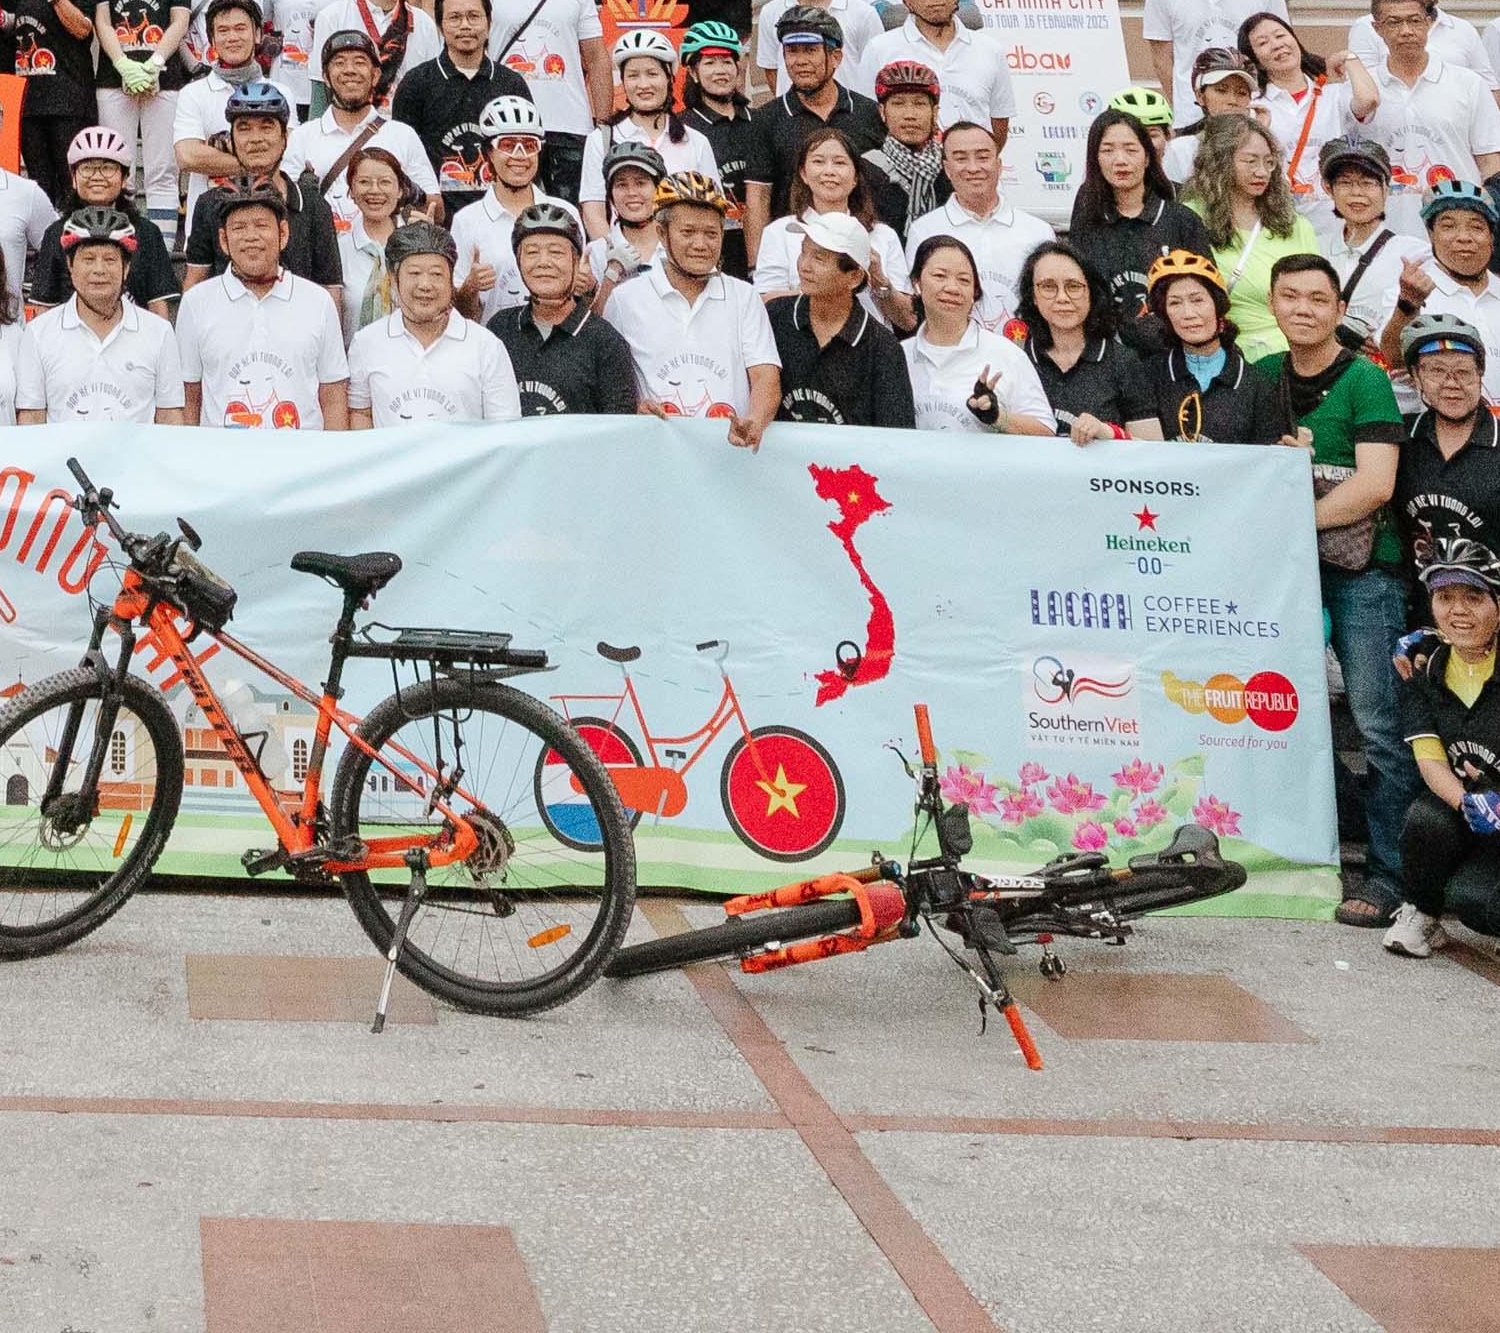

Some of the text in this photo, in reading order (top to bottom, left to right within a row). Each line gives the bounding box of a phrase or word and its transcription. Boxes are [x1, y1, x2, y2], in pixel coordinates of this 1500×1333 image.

[996, 14, 1109, 29] TOUR 16 FEBRUARY 2025
[1089, 477, 1200, 497] SPONSORS:
[1105, 535, 1192, 554] Heineken
[1143, 595, 1221, 615] COFFEE
[1145, 617, 1281, 638] EXPERIENCES
[1182, 687, 1298, 712] THE FRUIT REPUBLIC
[1028, 711, 1139, 734] SouthernViet
[1119, 739, 1140, 747] NAM
[1198, 733, 1288, 751] Sourced for you
